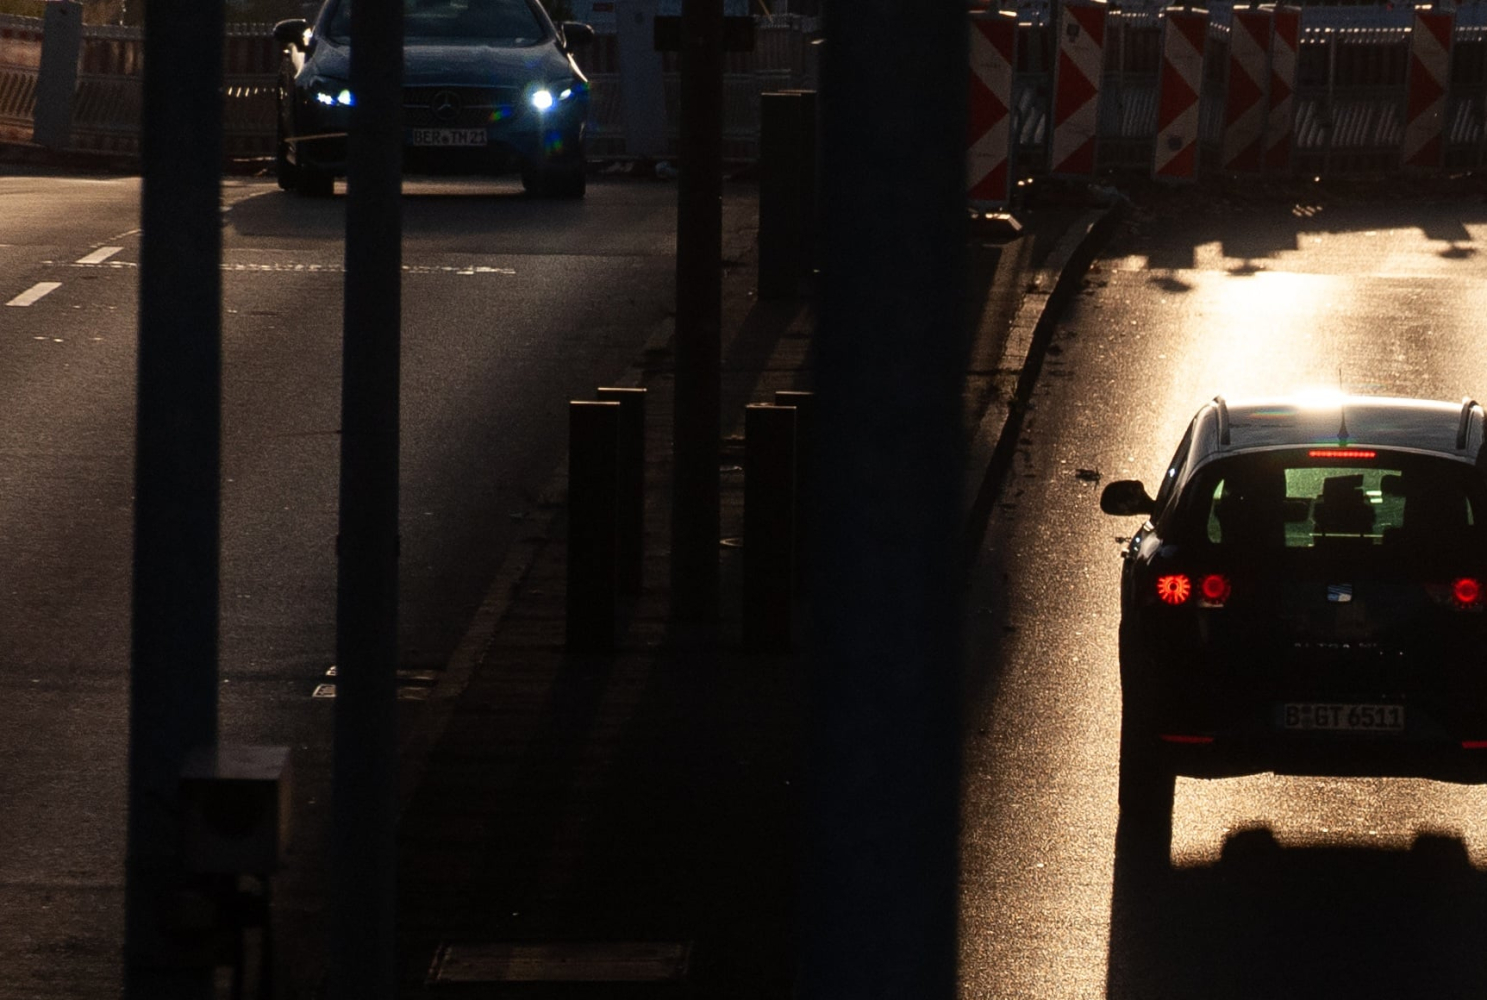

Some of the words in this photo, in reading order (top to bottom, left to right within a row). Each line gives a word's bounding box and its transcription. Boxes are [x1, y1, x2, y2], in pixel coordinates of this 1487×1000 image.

[414, 130, 441, 144] BER
[469, 130, 485, 144] 21
[1286, 706, 1300, 727] B
[1315, 706, 1343, 727] GT
[1348, 706, 1401, 728] 6511
